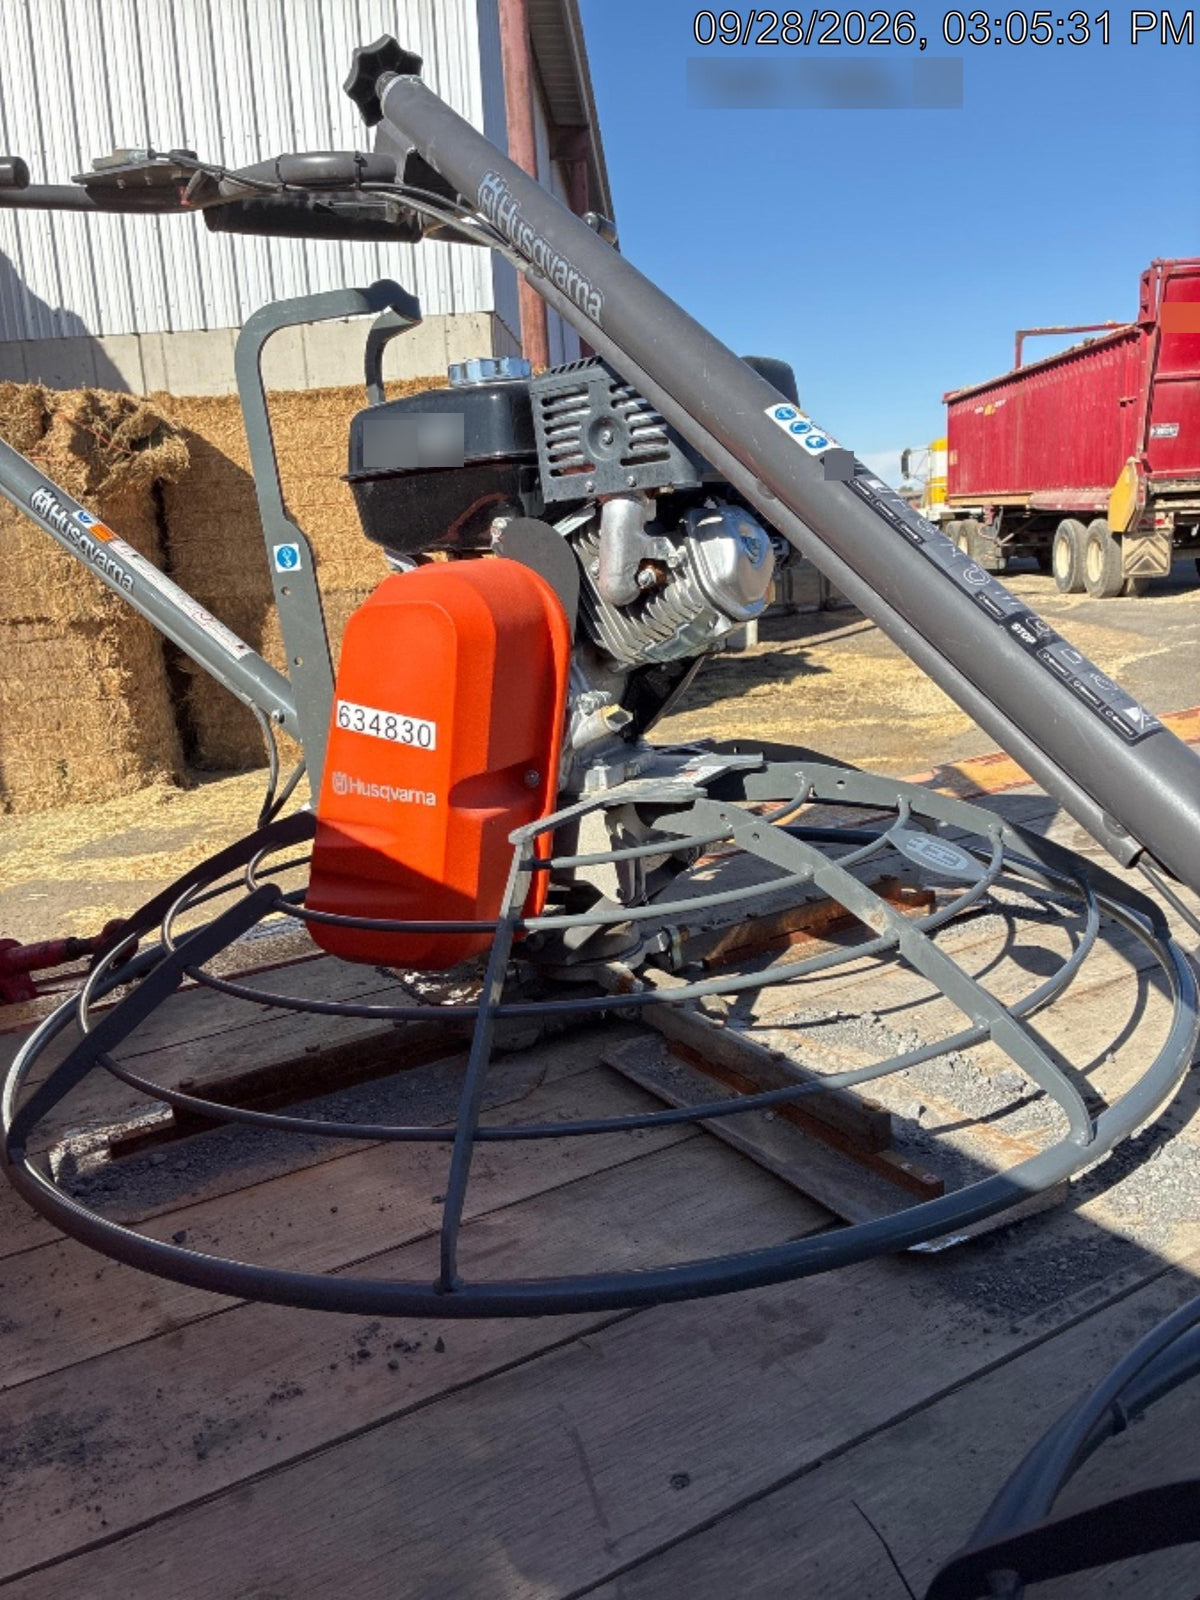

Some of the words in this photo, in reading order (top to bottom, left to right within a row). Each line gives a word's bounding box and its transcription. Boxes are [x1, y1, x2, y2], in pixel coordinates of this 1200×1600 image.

[497, 192, 604, 322] Husqvarna
[49, 503, 134, 592] Husqvarna
[1011, 622, 1037, 644] STOP
[339, 705, 431, 748] 634830
[349, 776, 437, 807] Husqvarna
